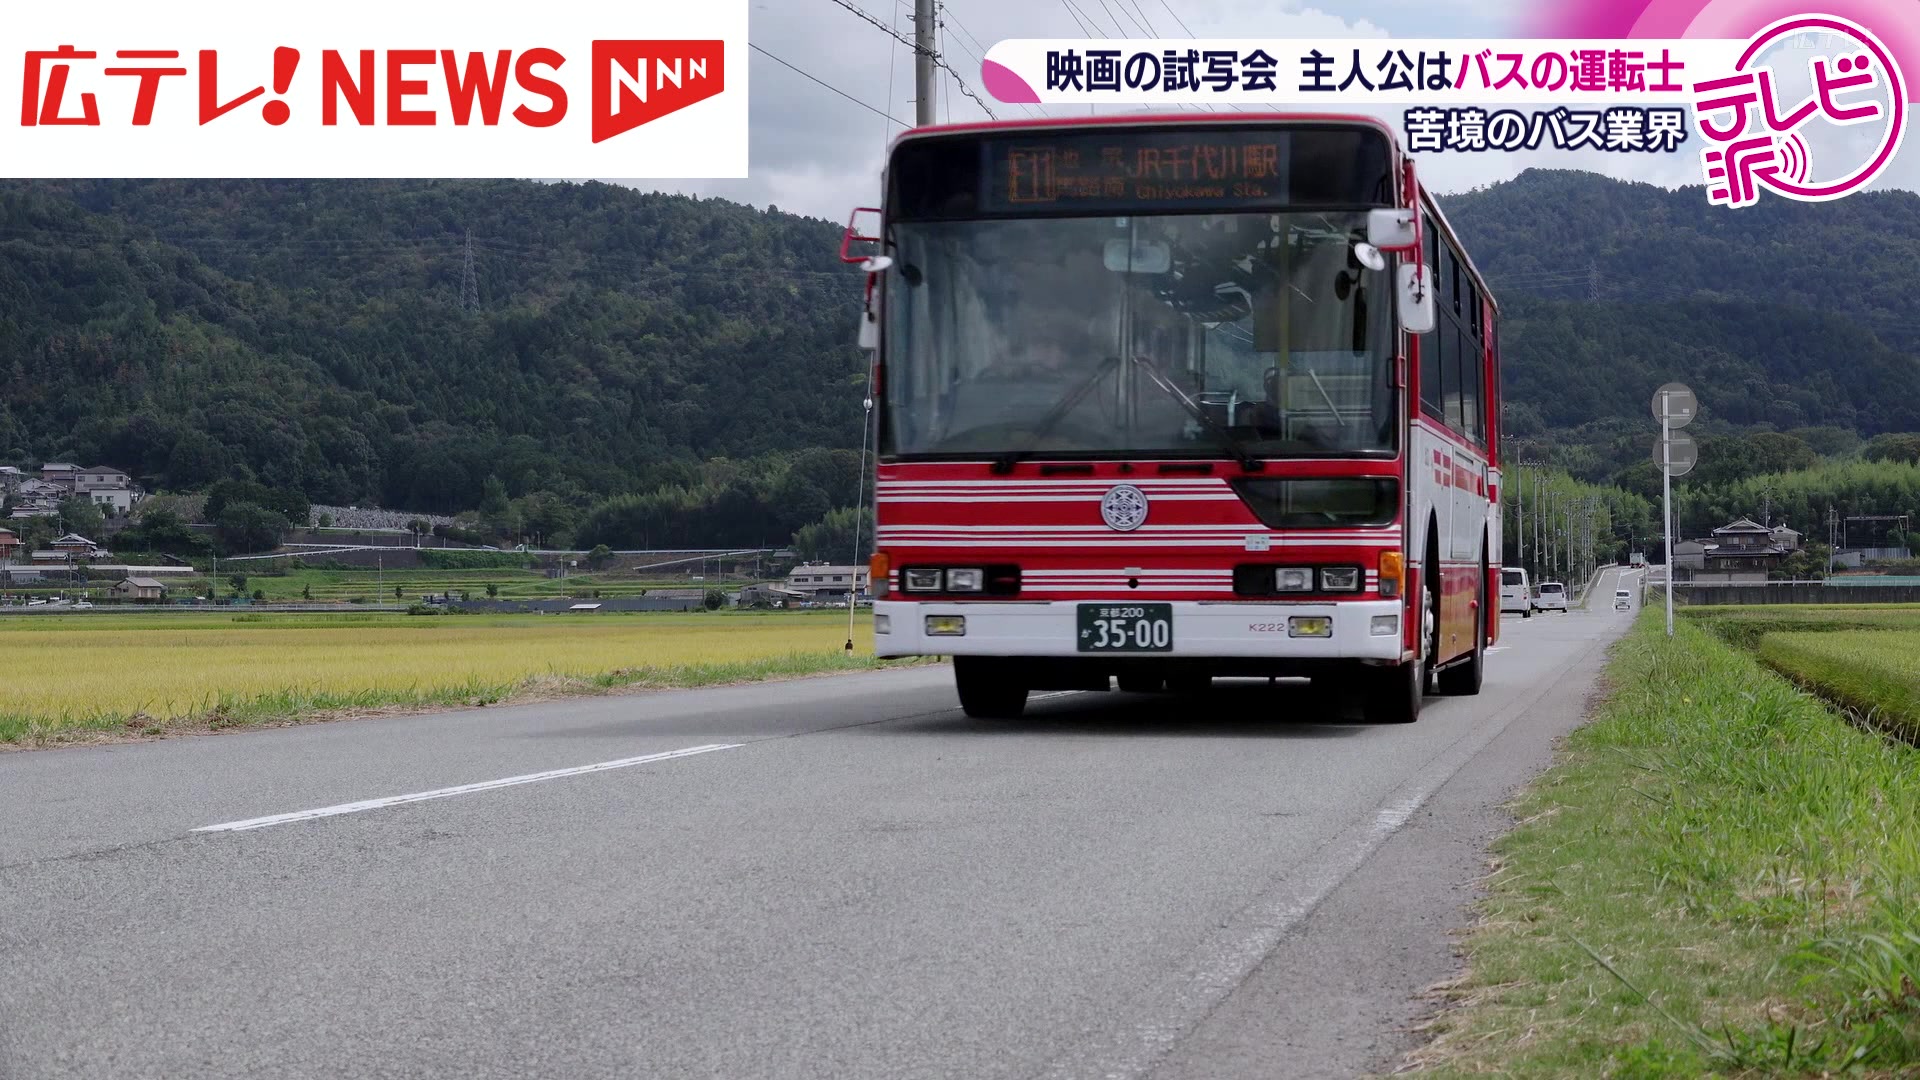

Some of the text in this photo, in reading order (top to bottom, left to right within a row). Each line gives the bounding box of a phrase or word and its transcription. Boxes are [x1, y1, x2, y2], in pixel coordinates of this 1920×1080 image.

[1134, 144, 1278, 179] JR千代川駅
[1135, 184, 1225, 200] Chiyokawa
[1099, 607, 1145, 618] 京都200
[1093, 619, 1169, 648] 35-00
[1248, 623, 1285, 632] K222
